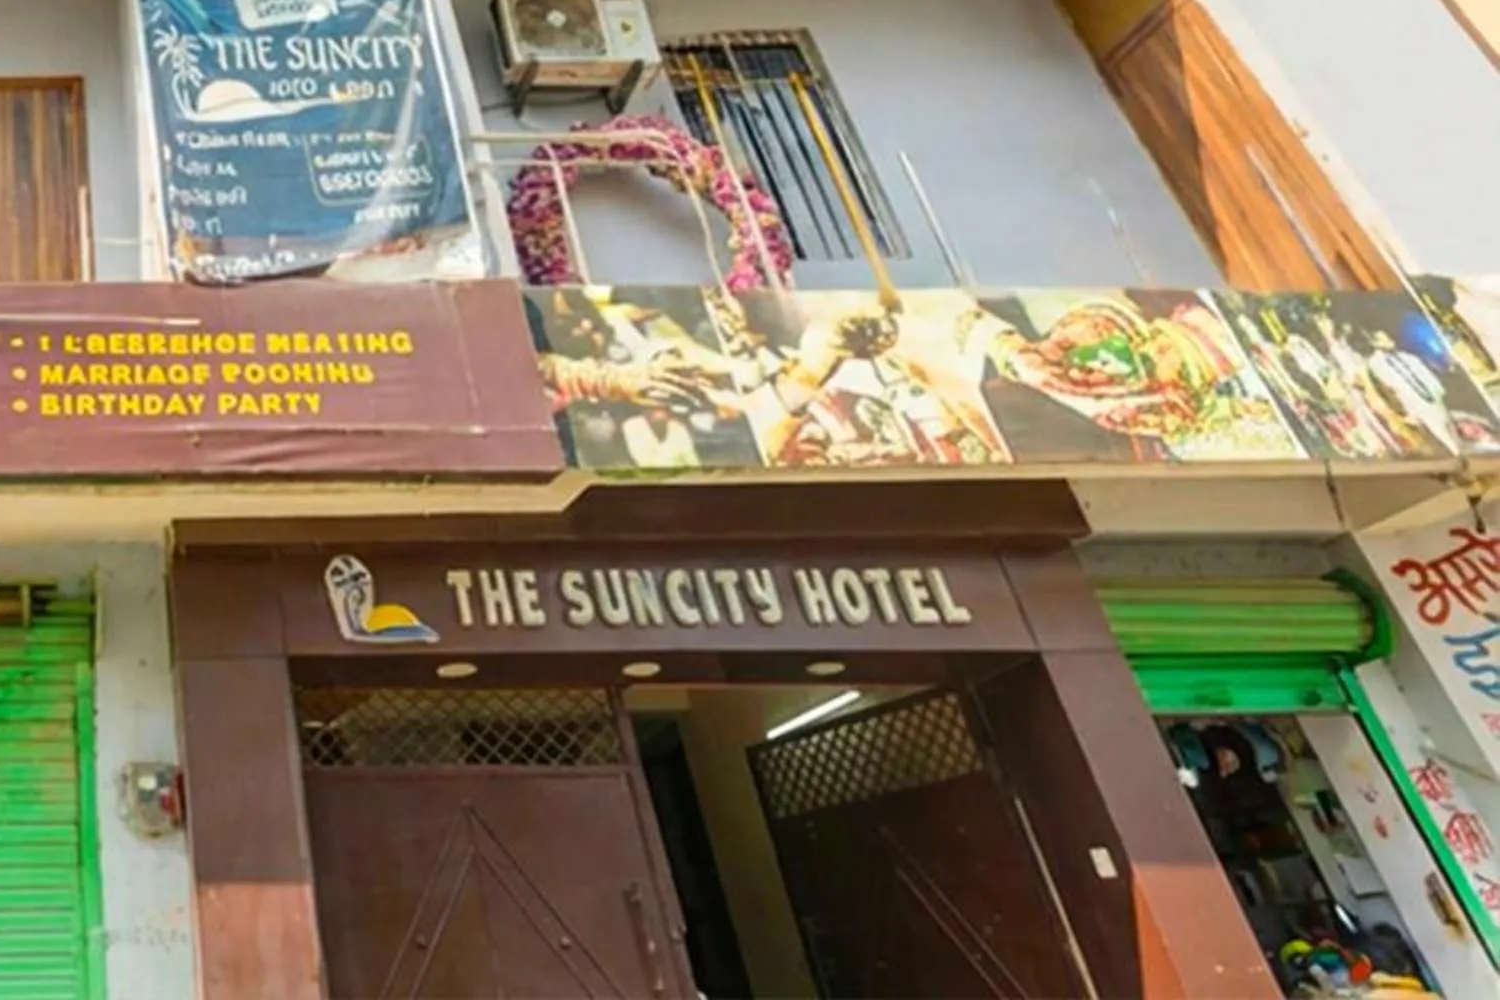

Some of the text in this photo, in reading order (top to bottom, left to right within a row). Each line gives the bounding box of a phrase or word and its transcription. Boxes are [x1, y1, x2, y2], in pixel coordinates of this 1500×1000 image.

[285, 33, 424, 74] SUNCITY
[39, 391, 321, 416] BIRTHDAY PARTY
[446, 566, 973, 629] THE SUNCITY HOTEL
